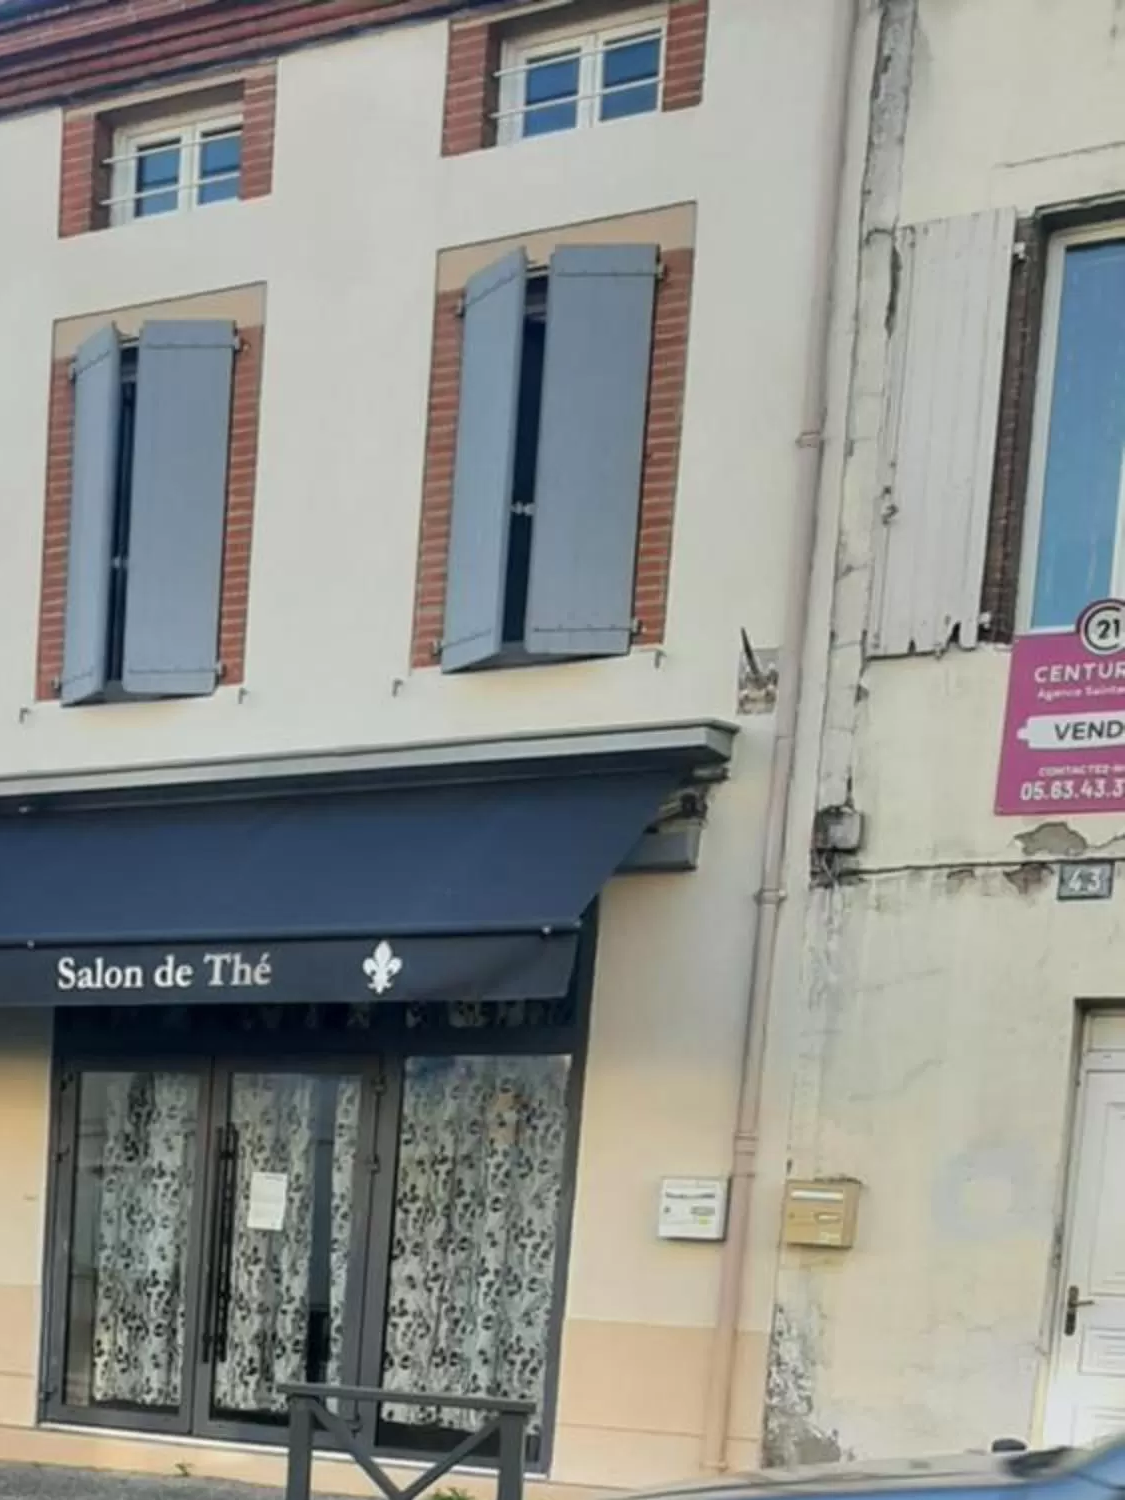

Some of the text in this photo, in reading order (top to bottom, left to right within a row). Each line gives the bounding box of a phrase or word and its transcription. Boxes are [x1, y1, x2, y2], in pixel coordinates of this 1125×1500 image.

[1096, 619, 1120, 640] 21
[1055, 719, 1125, 741] VEND
[1020, 778, 1125, 800] 05.63.43.3
[1068, 868, 1101, 893] 43
[58, 953, 272, 989] Salon de Thé
